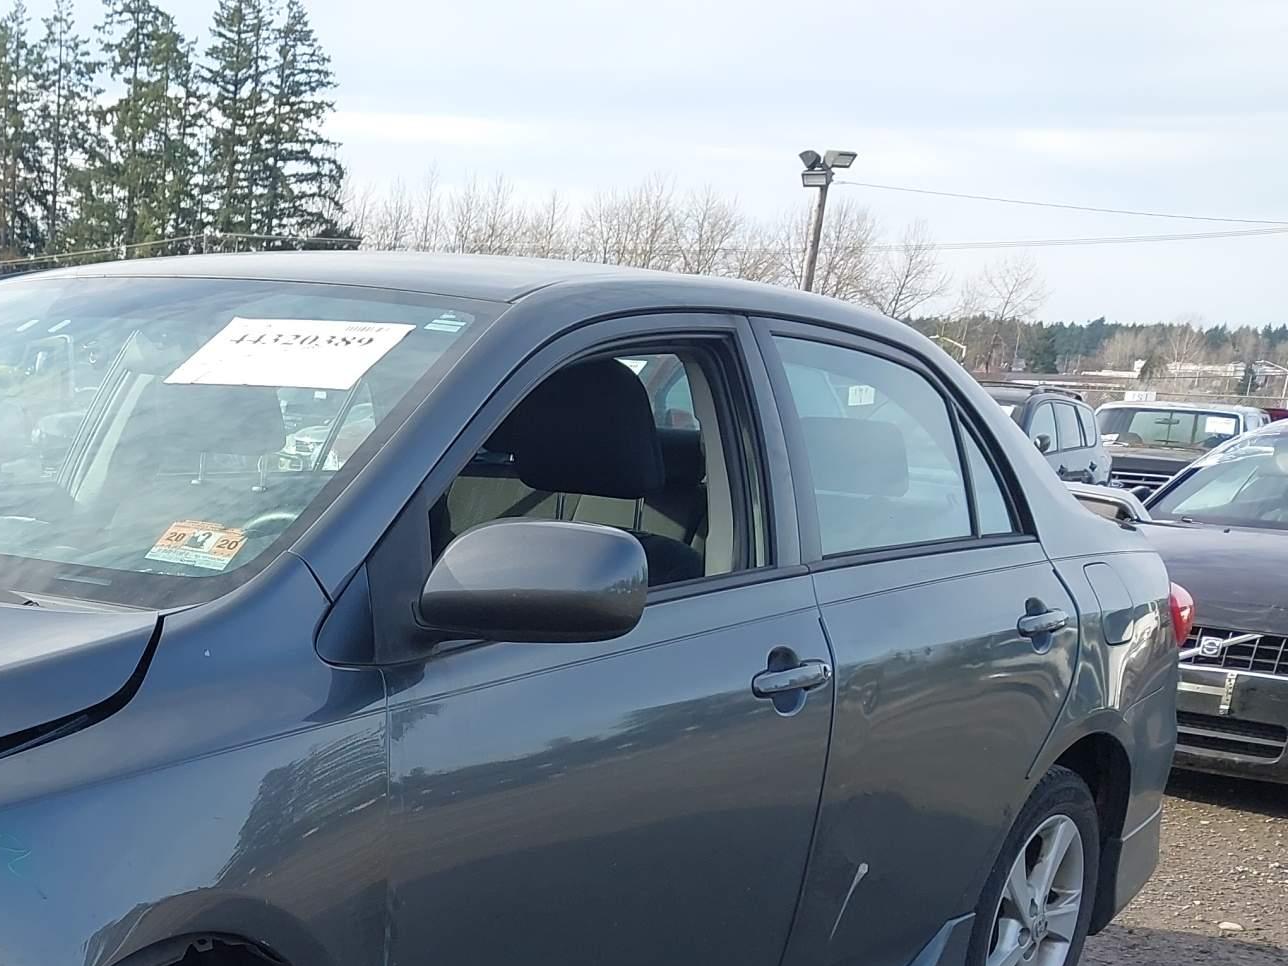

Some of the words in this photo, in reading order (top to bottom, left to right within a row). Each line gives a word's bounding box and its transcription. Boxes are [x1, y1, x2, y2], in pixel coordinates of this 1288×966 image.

[229, 333, 375, 347] 44320389
[165, 531, 187, 543] 20
[215, 538, 239, 551] 20
